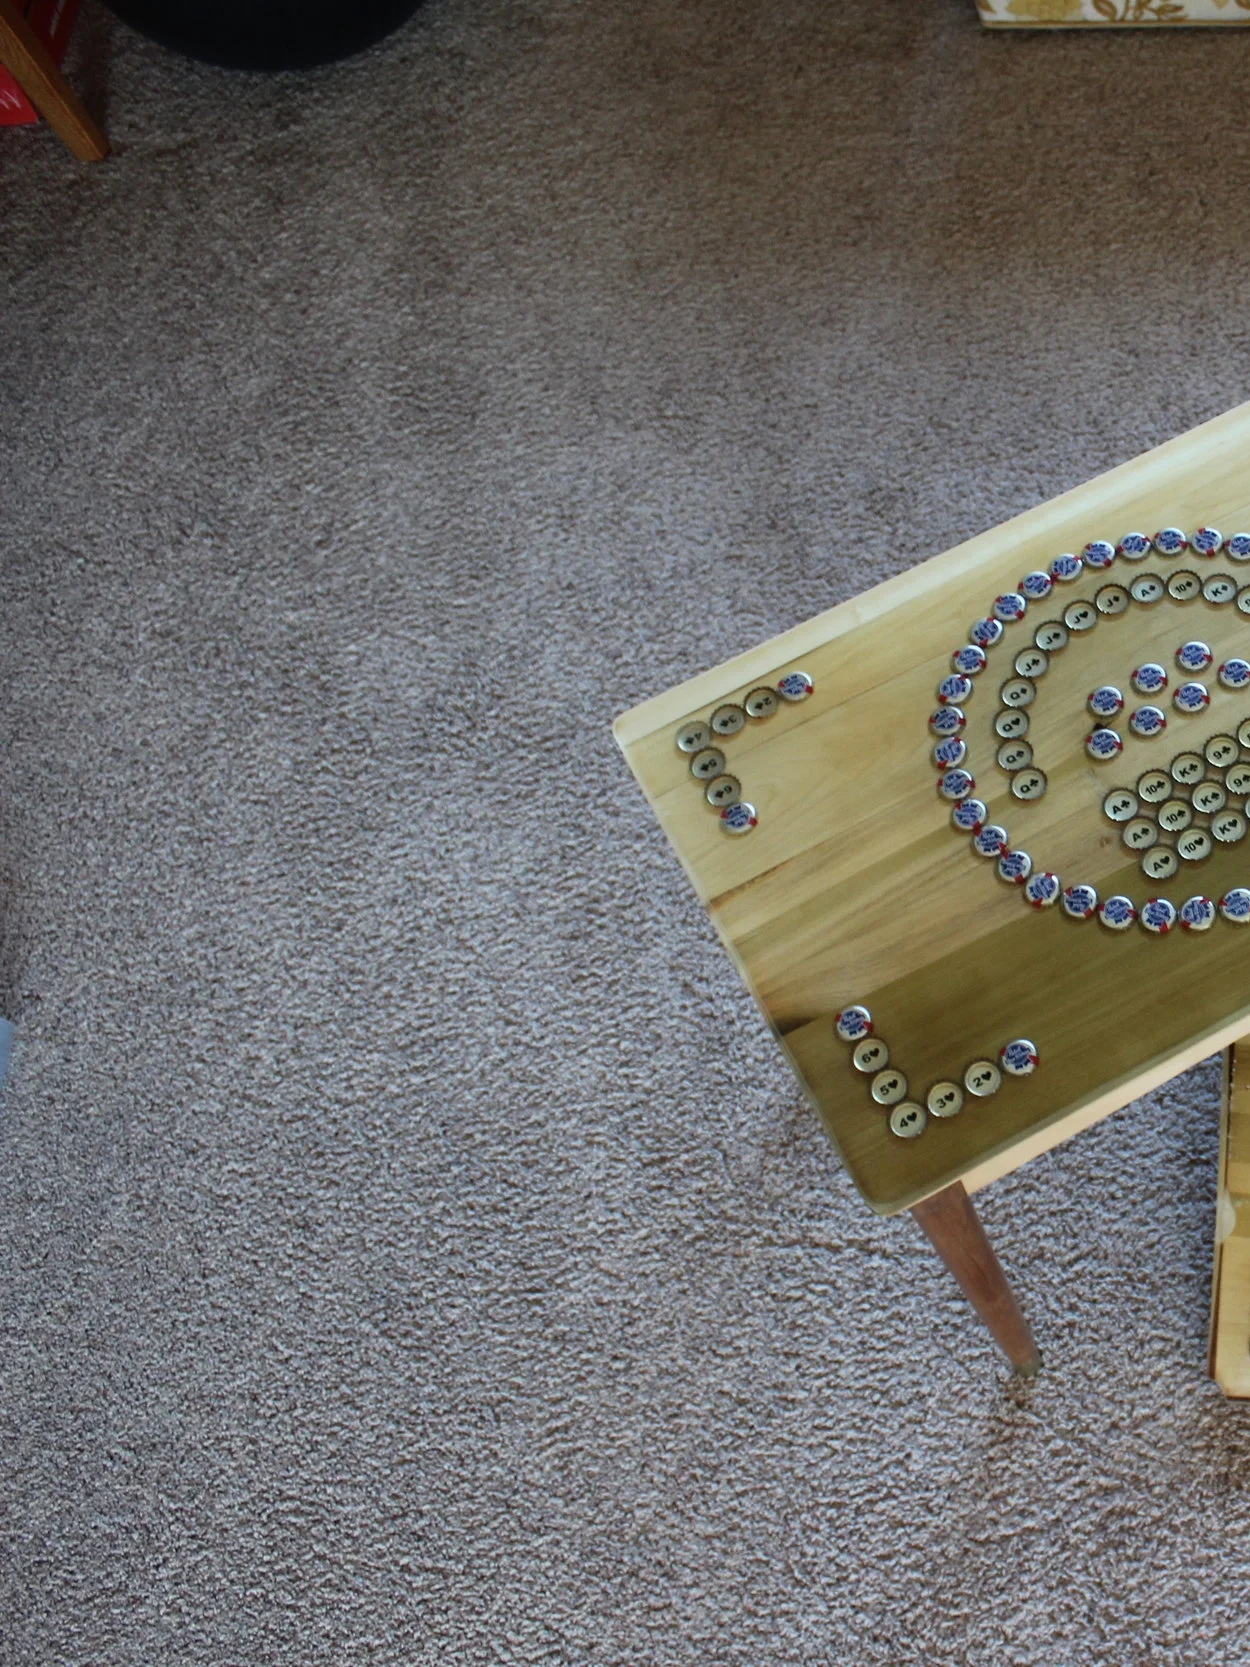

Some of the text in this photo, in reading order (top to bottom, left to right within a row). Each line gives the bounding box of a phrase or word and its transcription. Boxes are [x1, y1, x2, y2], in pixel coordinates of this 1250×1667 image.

[1141, 589, 1149, 597] A
[1175, 584, 1186, 593] 10
[1211, 588, 1222, 597] K
[1107, 599, 1113, 607] J
[1074, 616, 1081, 624] J
[1046, 636, 1052, 644] J
[1025, 663, 1032, 671] J
[1010, 691, 1020, 700] Q
[1003, 723, 1013, 732] Q
[1006, 755, 1017, 763] Q
[1213, 750, 1223, 759] 9
[1178, 768, 1190, 778] K
[1233, 778, 1242, 787] 9
[1020, 785, 1031, 793] Q
[1145, 785, 1157, 796] 10
[1200, 796, 1212, 806] K
[1112, 805, 1122, 814] A
[1166, 813, 1178, 823] 10
[1218, 824, 1230, 834] K
[1131, 832, 1142, 842] A
[1184, 842, 1195, 853] 10
[1153, 862, 1163, 872] A
[862, 1054, 871, 1063] 6
[973, 1077, 983, 1087] 2
[880, 1085, 889, 1096] 5
[936, 1098, 946, 1108] 3
[899, 1118, 908, 1128] 4
